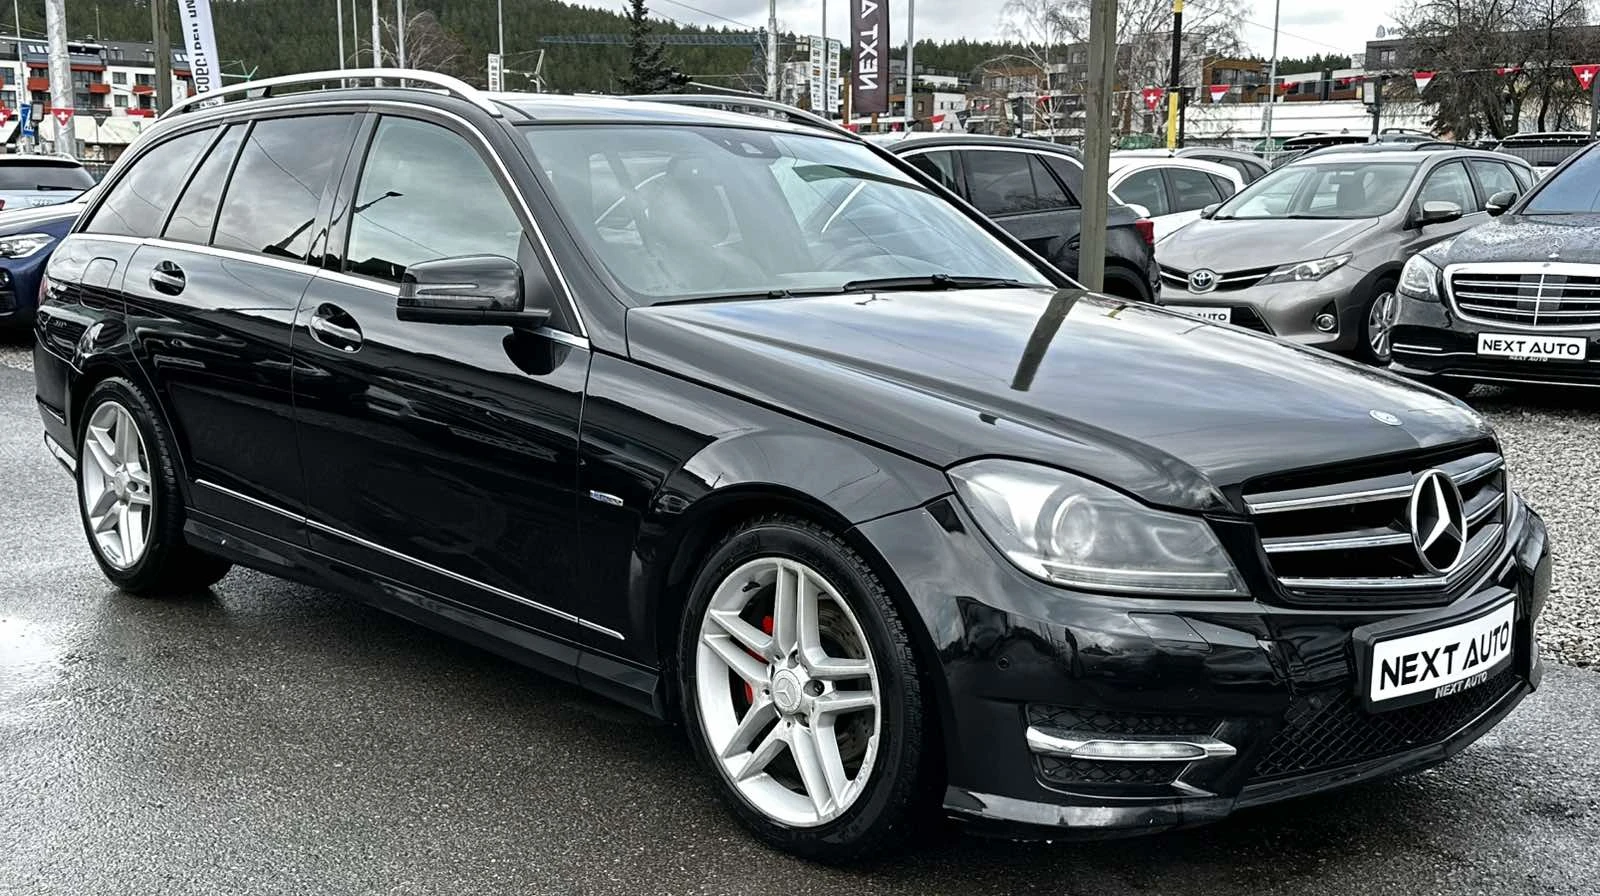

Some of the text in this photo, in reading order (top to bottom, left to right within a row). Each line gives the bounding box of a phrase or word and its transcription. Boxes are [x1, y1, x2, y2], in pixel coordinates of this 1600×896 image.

[1197, 313, 1227, 321] UTO
[1483, 339, 1580, 355] NEXT AUTO
[1380, 620, 1509, 690] NEXT AUTO
[1434, 671, 1488, 699] NEXT AUTO
